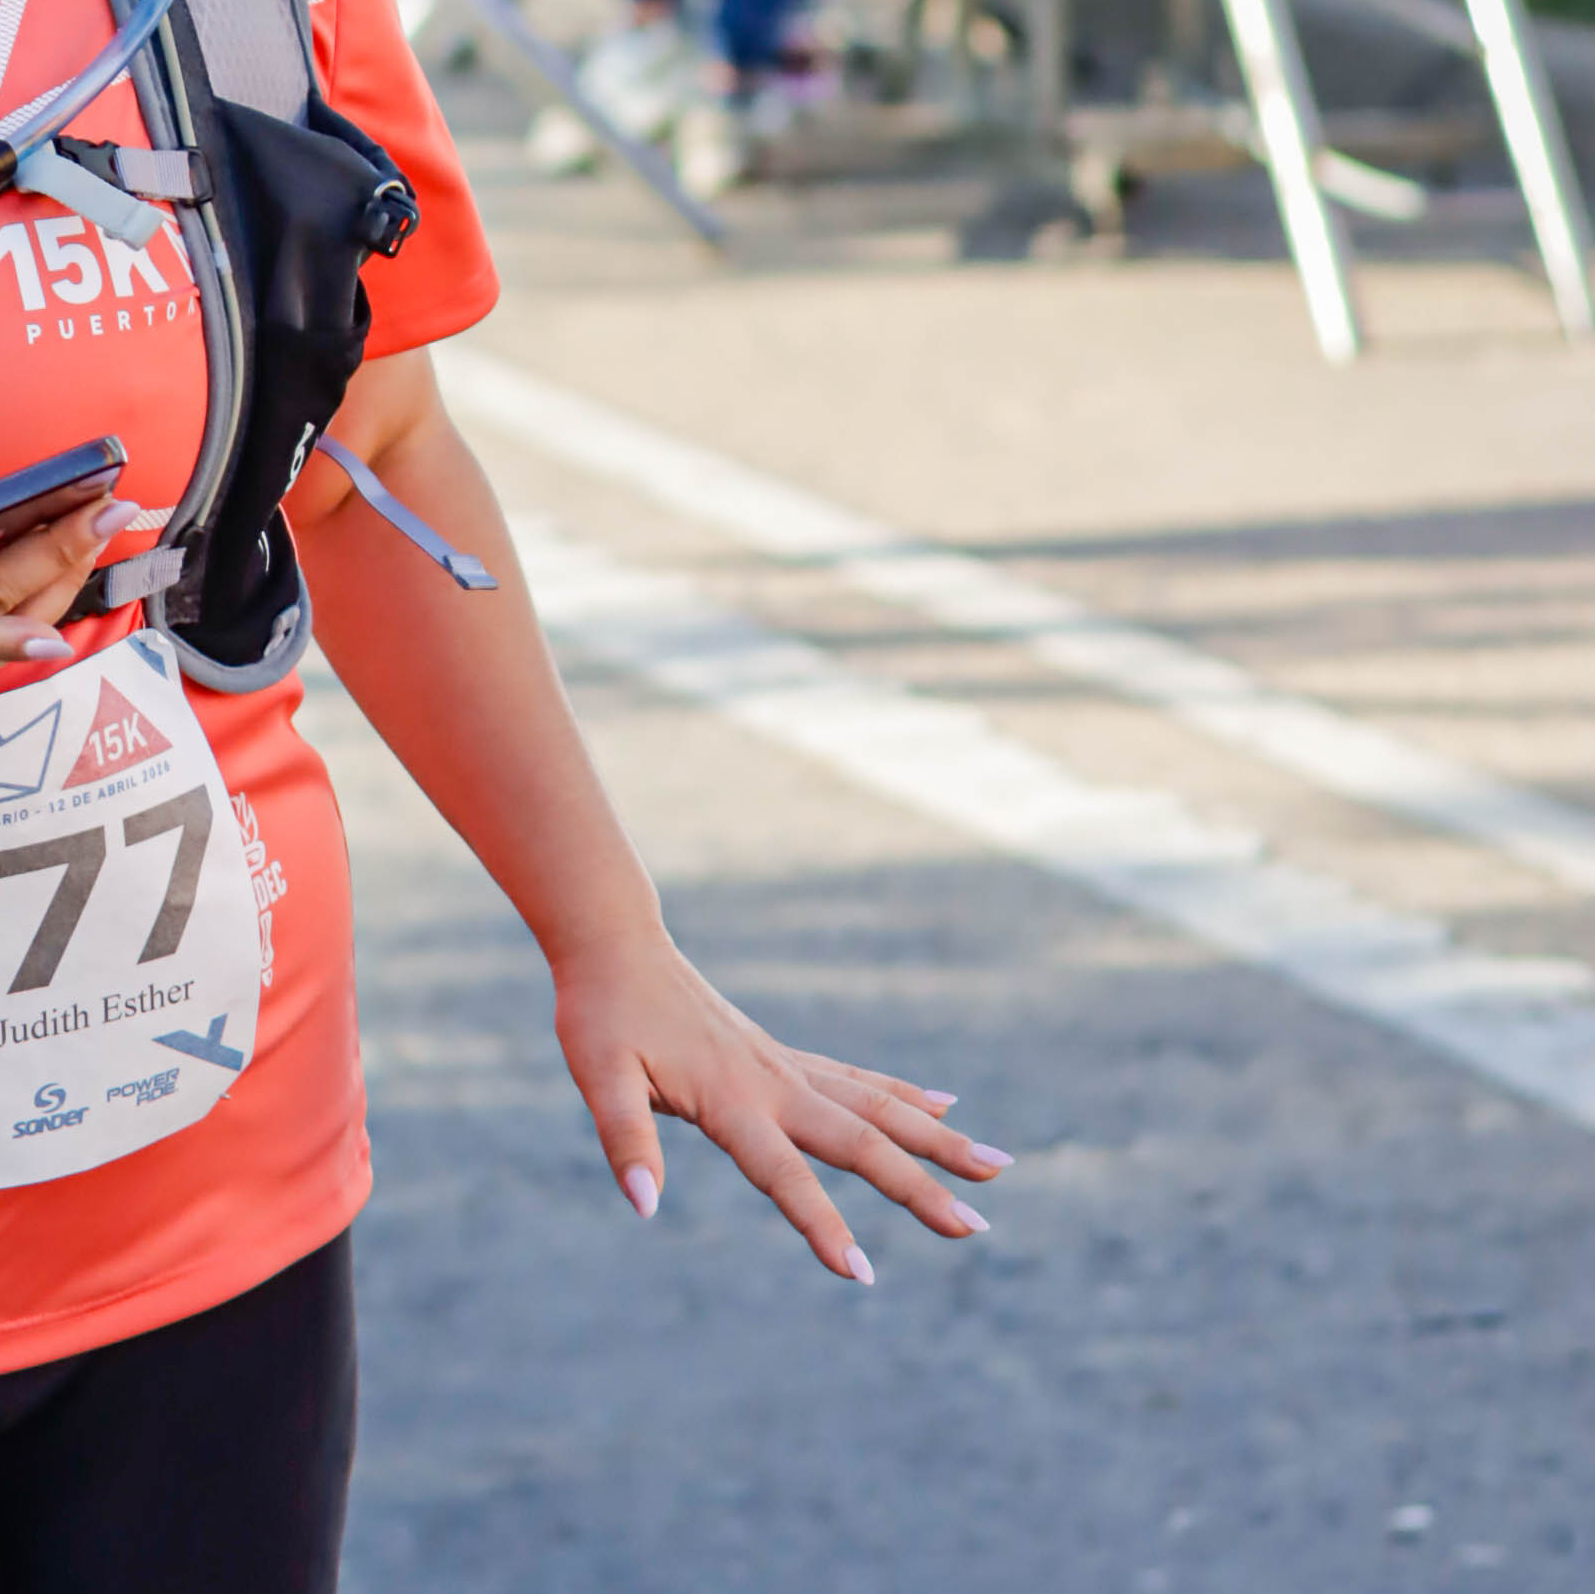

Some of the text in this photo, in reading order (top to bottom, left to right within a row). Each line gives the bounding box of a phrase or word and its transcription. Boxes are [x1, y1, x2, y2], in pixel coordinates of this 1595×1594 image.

[26, 301, 178, 345] PUERTO
[89, 712, 149, 767] 15K
[49, 798, 66, 814] 12
[72, 792, 92, 808] DE
[97, 776, 138, 800] ABRIL
[142, 760, 171, 783] 2026
[102, 978, 196, 1025] Esther
[106, 1067, 180, 1104] POWER
